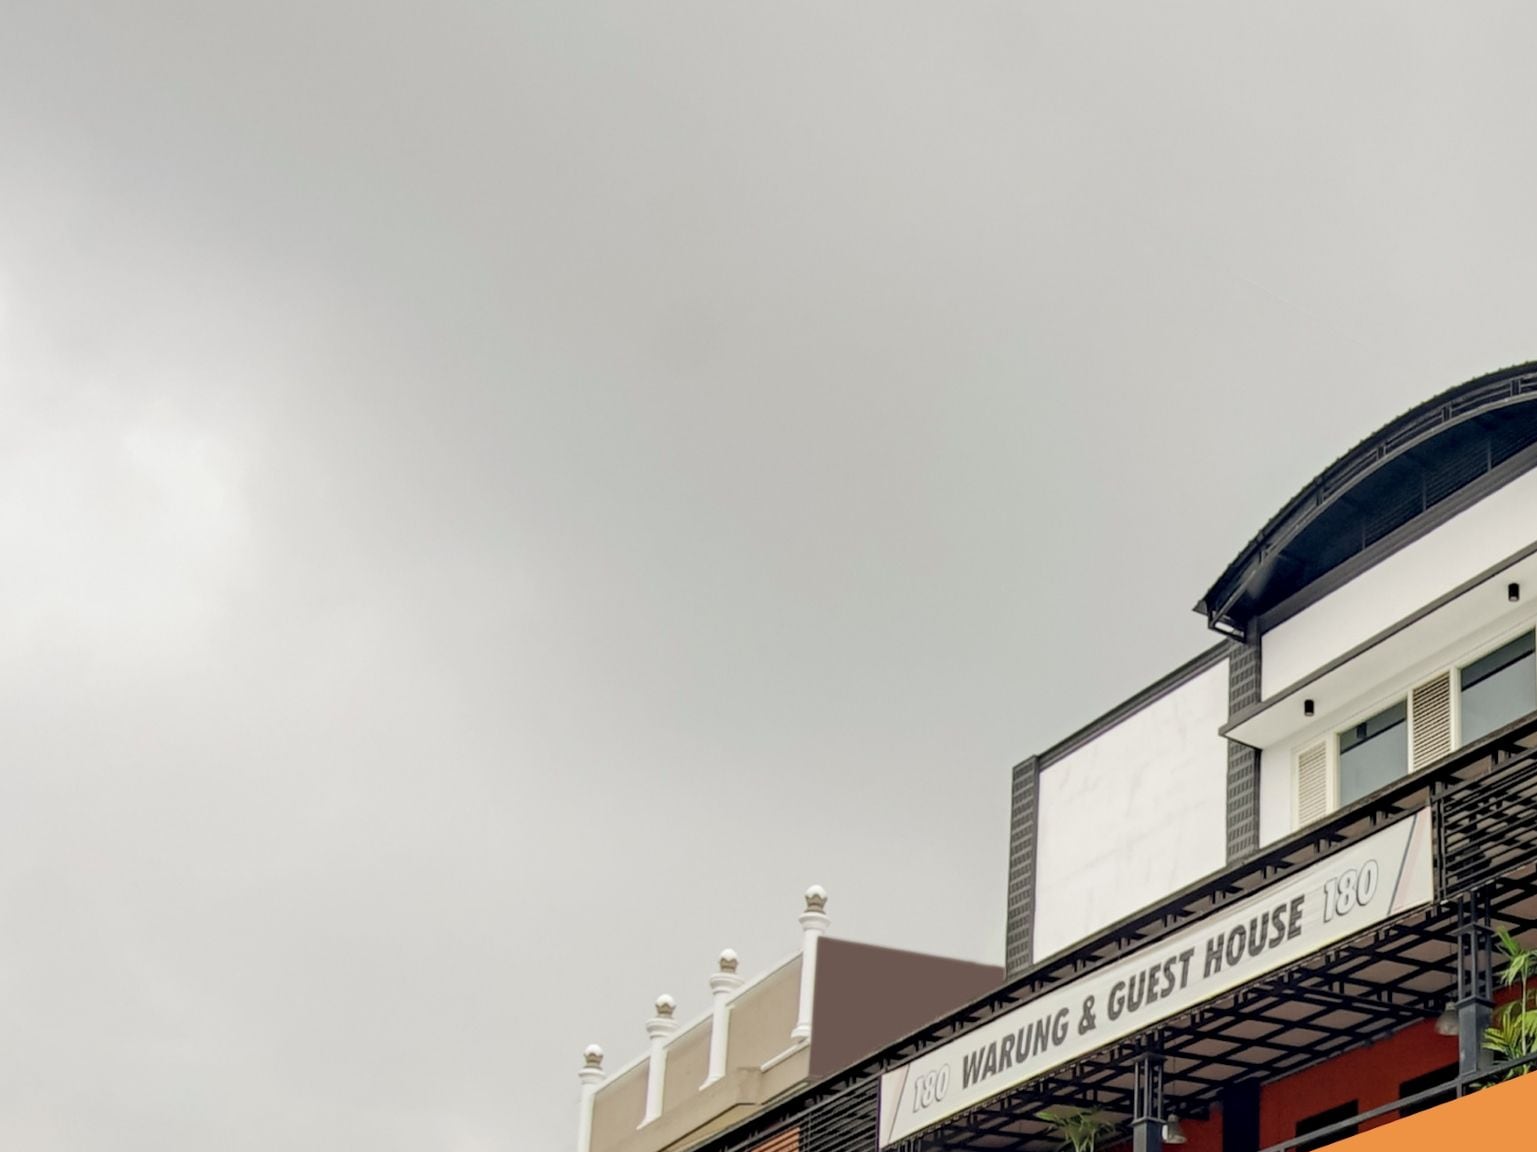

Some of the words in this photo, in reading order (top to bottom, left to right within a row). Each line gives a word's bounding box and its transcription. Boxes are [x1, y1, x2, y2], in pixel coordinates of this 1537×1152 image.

[912, 1063, 951, 1114] 180
[962, 1007, 1070, 1090] WARUNG
[1077, 995, 1097, 1036] &
[1108, 948, 1195, 1022] GUEST
[1203, 894, 1305, 981] HOUSE
[1323, 859, 1380, 925] 180
